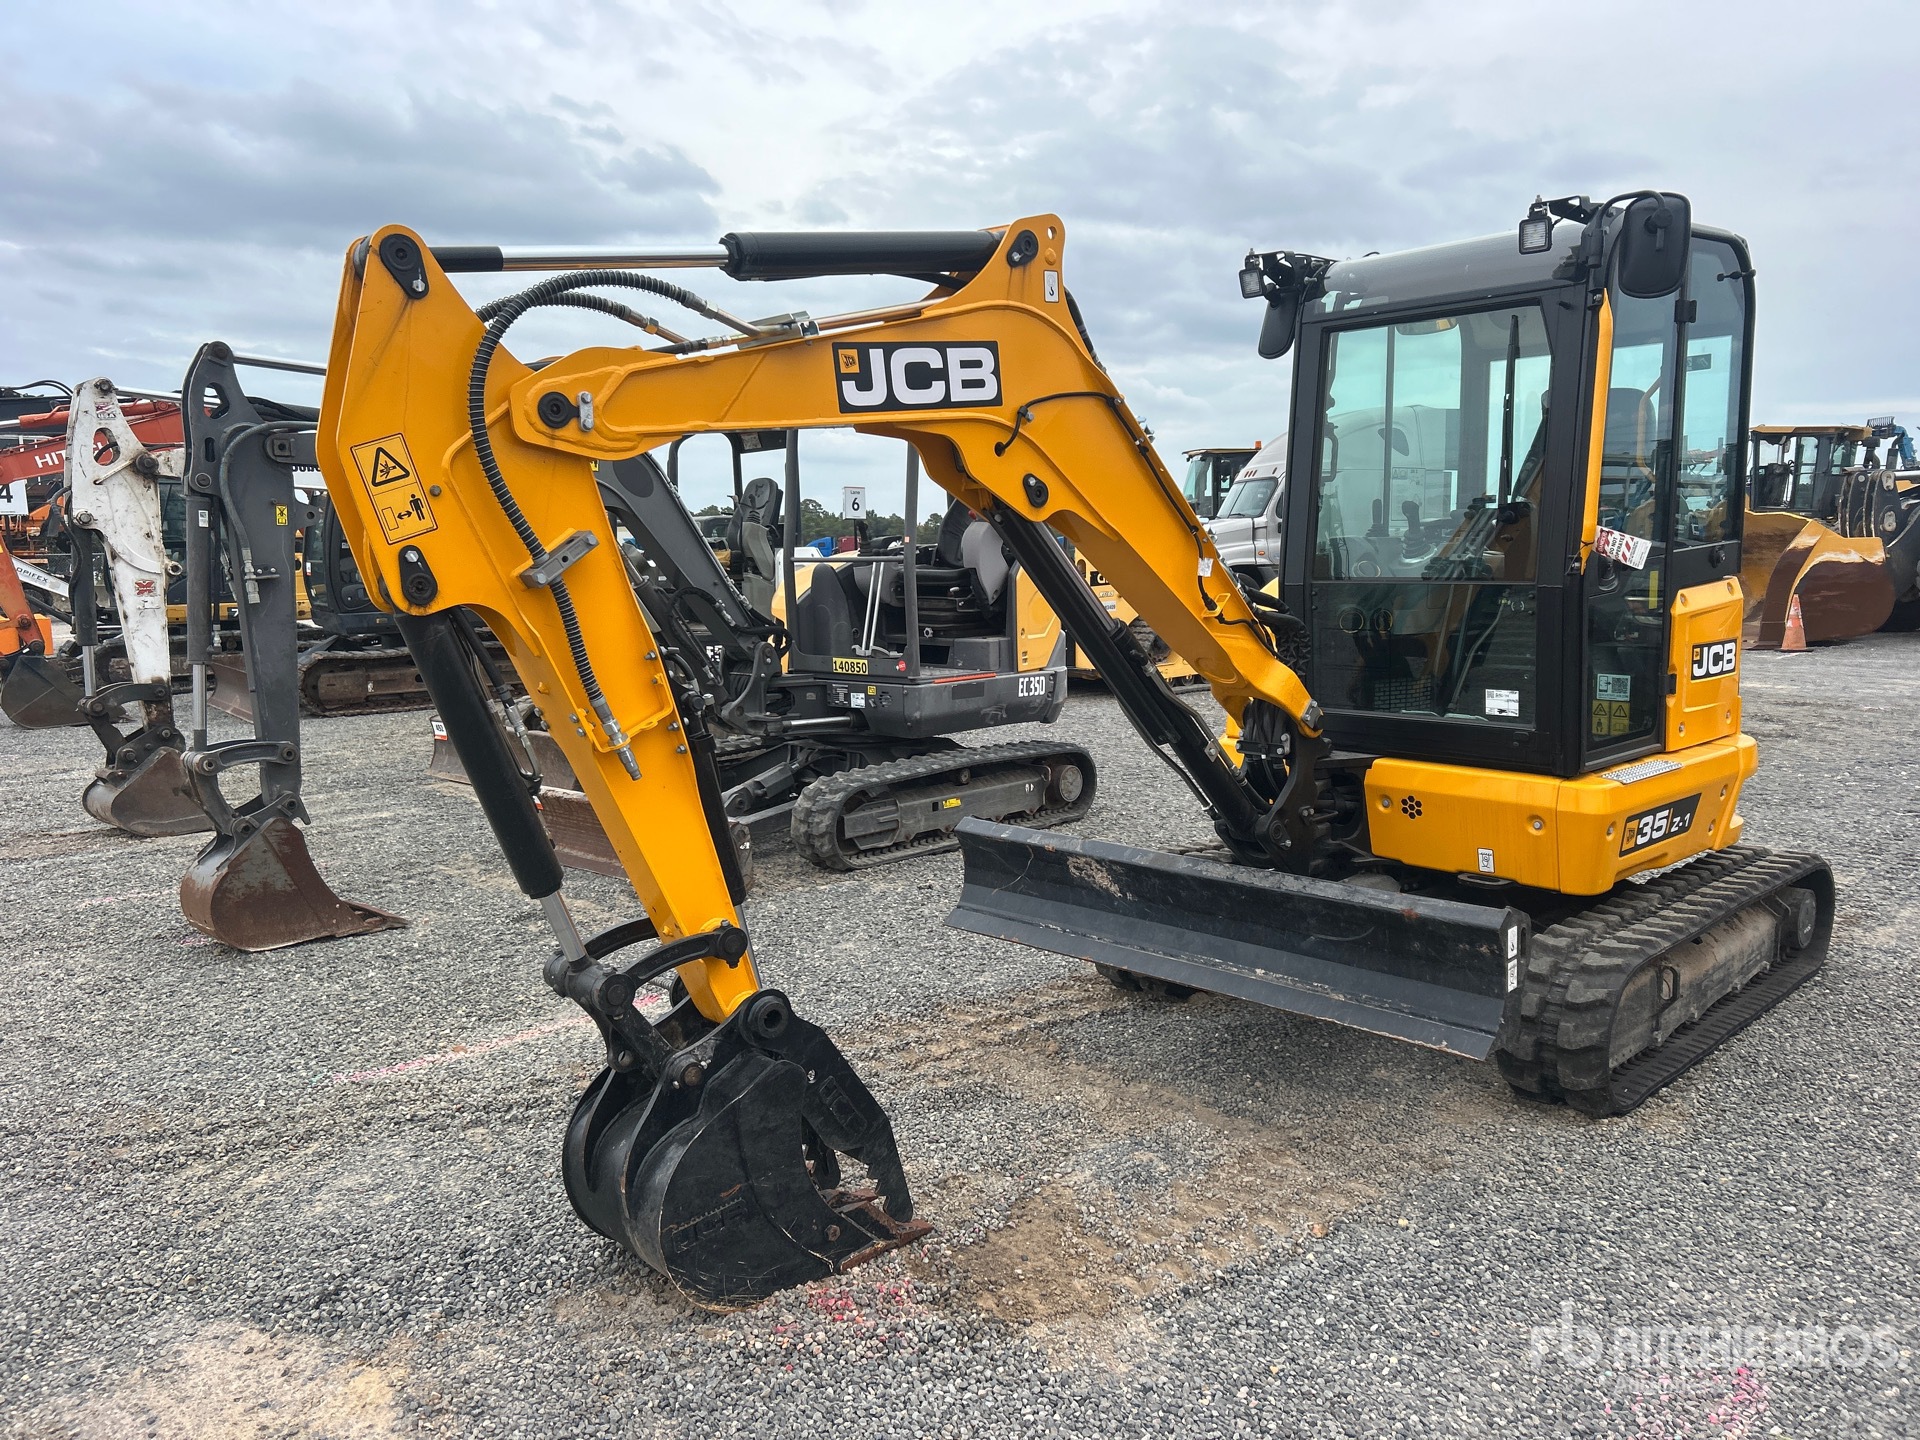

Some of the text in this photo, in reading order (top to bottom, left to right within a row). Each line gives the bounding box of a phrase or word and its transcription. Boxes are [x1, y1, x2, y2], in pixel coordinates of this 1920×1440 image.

[842, 347, 998, 407] JCB
[851, 497, 860, 511] 6
[833, 660, 868, 674] 140850
[1693, 642, 1736, 677] JCB
[1018, 676, 1046, 698] EC35D
